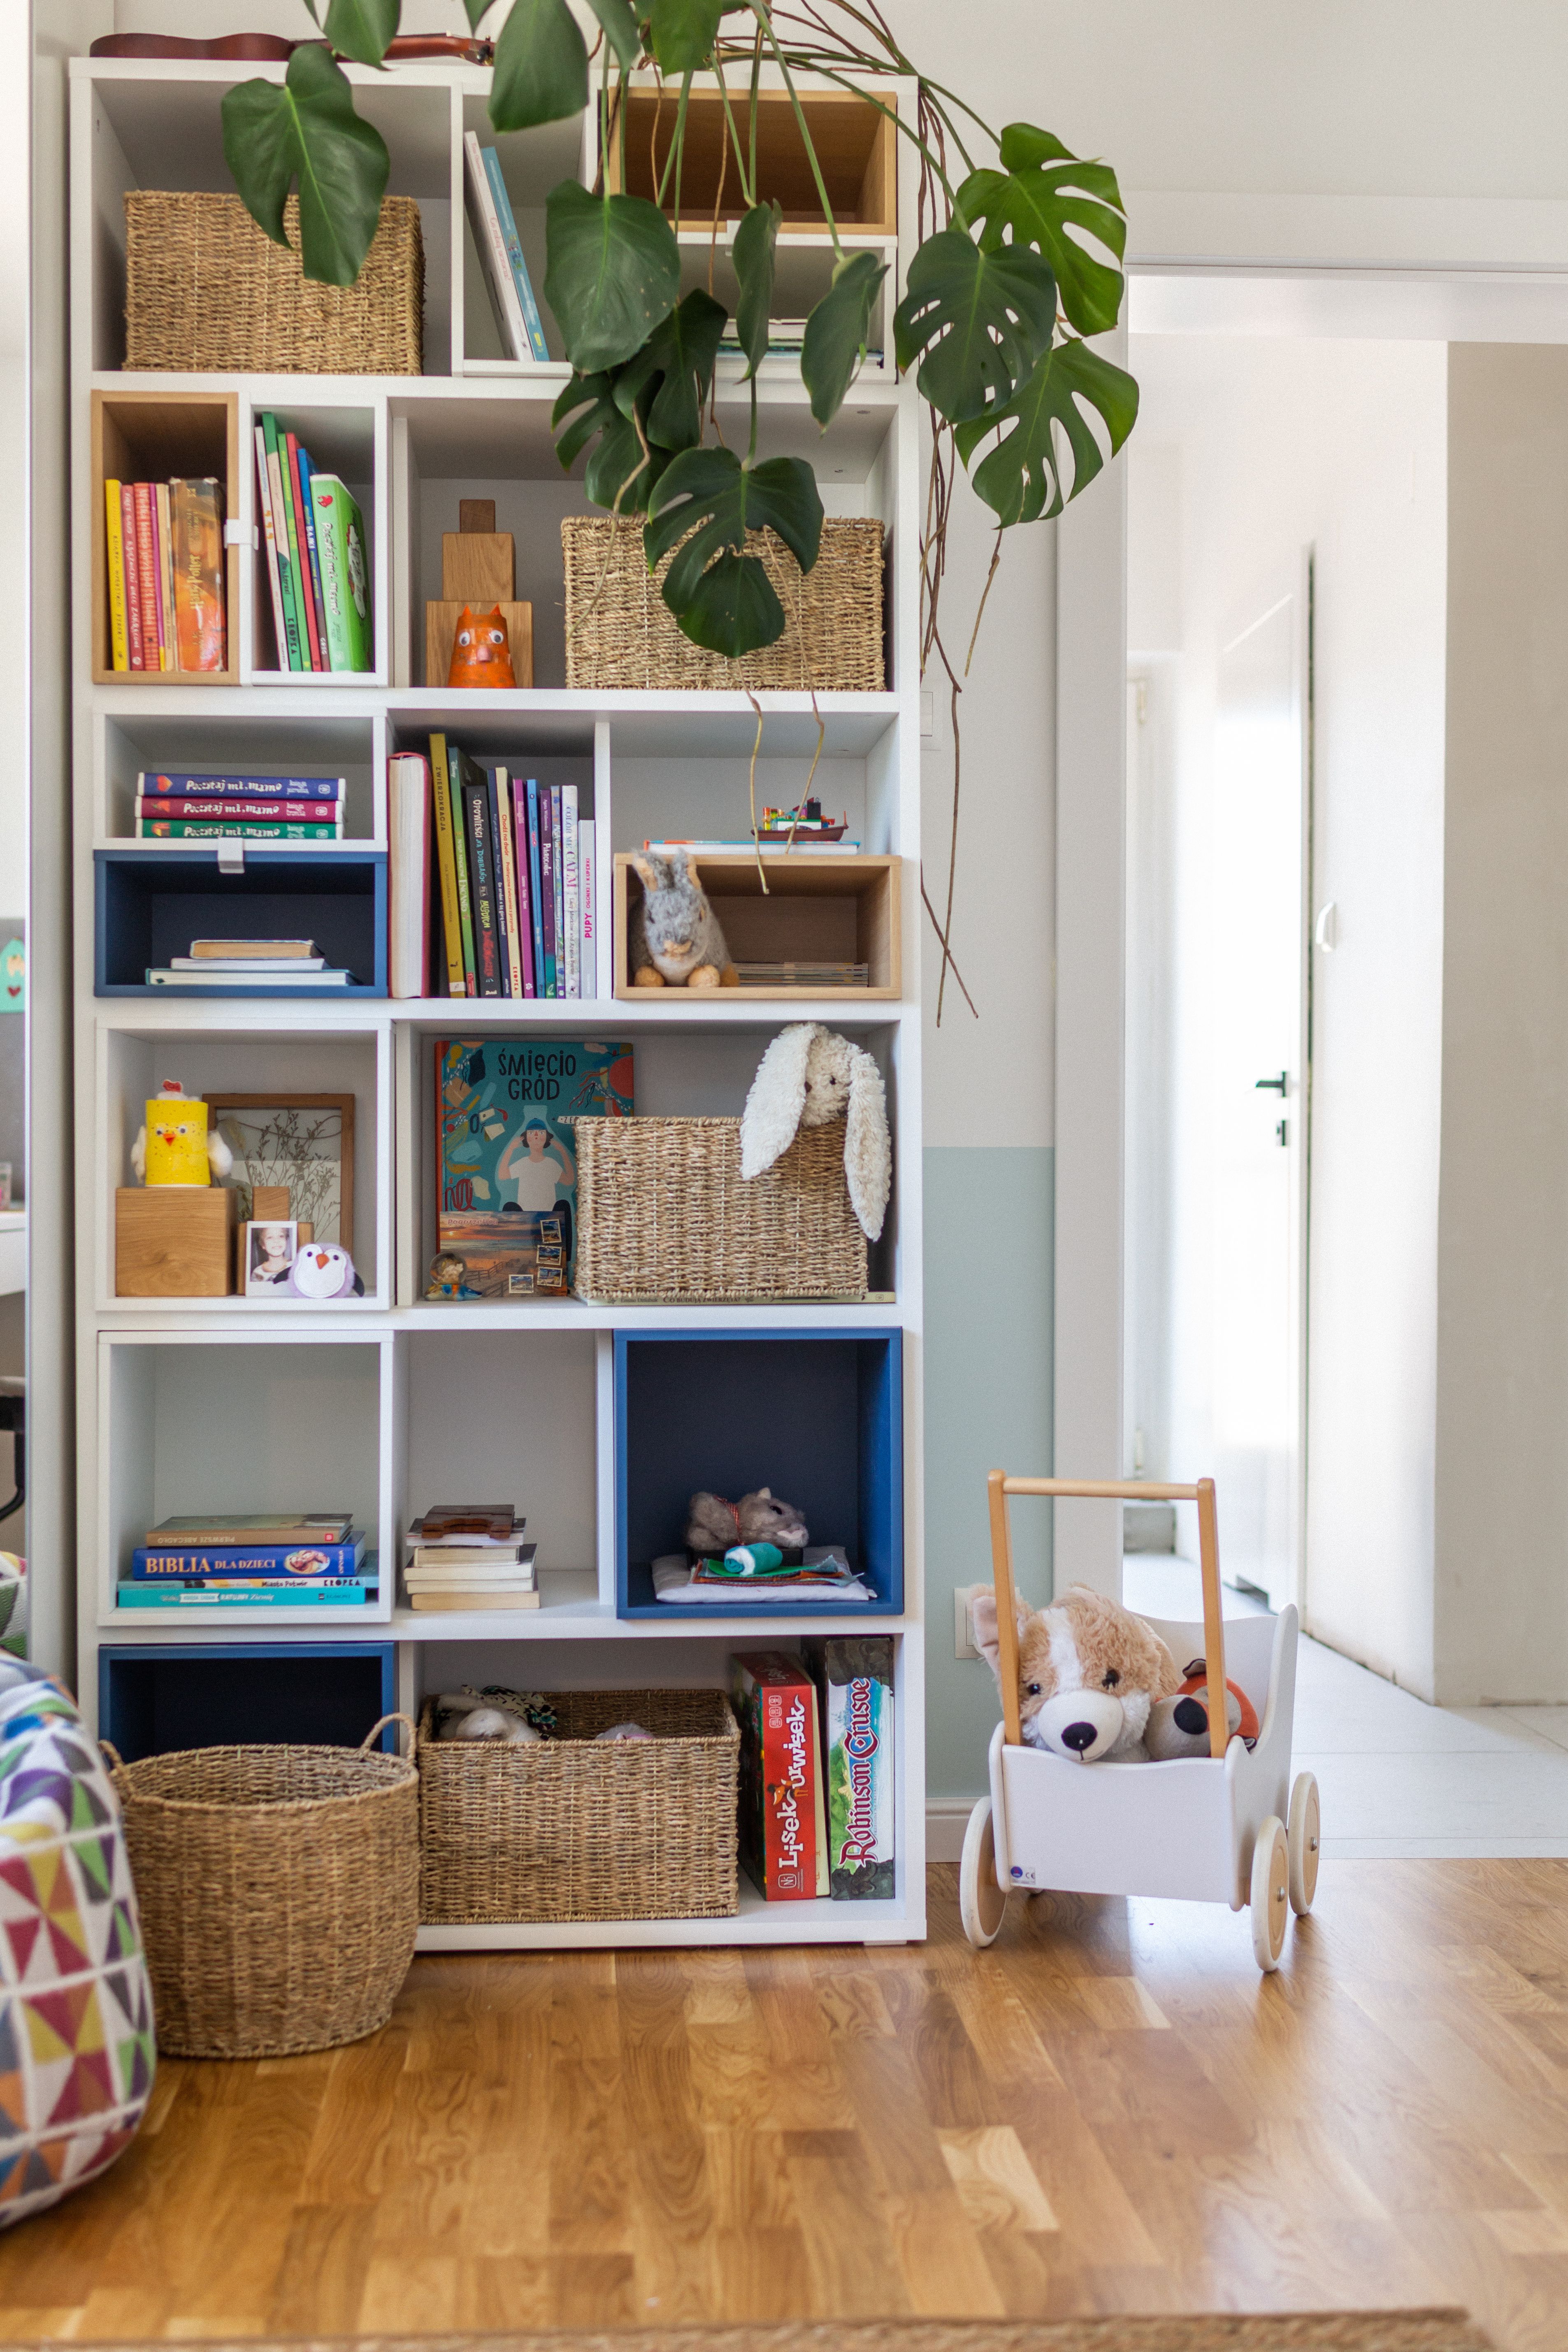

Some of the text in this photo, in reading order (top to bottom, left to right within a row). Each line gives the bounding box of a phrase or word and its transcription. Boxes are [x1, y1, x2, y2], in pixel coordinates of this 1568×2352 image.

[187, 555, 204, 585] Potter
[287, 618, 297, 654] KROPKA
[186, 778, 225, 792] Poczytaj
[248, 781, 282, 793] mamo
[436, 766, 446, 831] ZWIERZOKRACJA
[184, 802, 223, 814] Poczytaj
[245, 804, 279, 815] mamo
[472, 799, 485, 838] OPOWIEŚCI
[184, 825, 223, 837] Poczytaj
[246, 827, 280, 836] mamo
[565, 836, 572, 848] ME
[476, 849, 487, 883] DOBRANOC
[565, 851, 576, 887] CALM
[508, 1073, 560, 1101] GRÓD
[448, 1218, 498, 1226] Pogorzelica
[157, 1535, 235, 1544] PIERWSZE ABECADŁO
[145, 1556, 275, 1573] BIBLIA DLA DZIECI
[777, 1694, 806, 1869] Lisek urwisek
[839, 1677, 879, 1867] Robinson Crusoe
